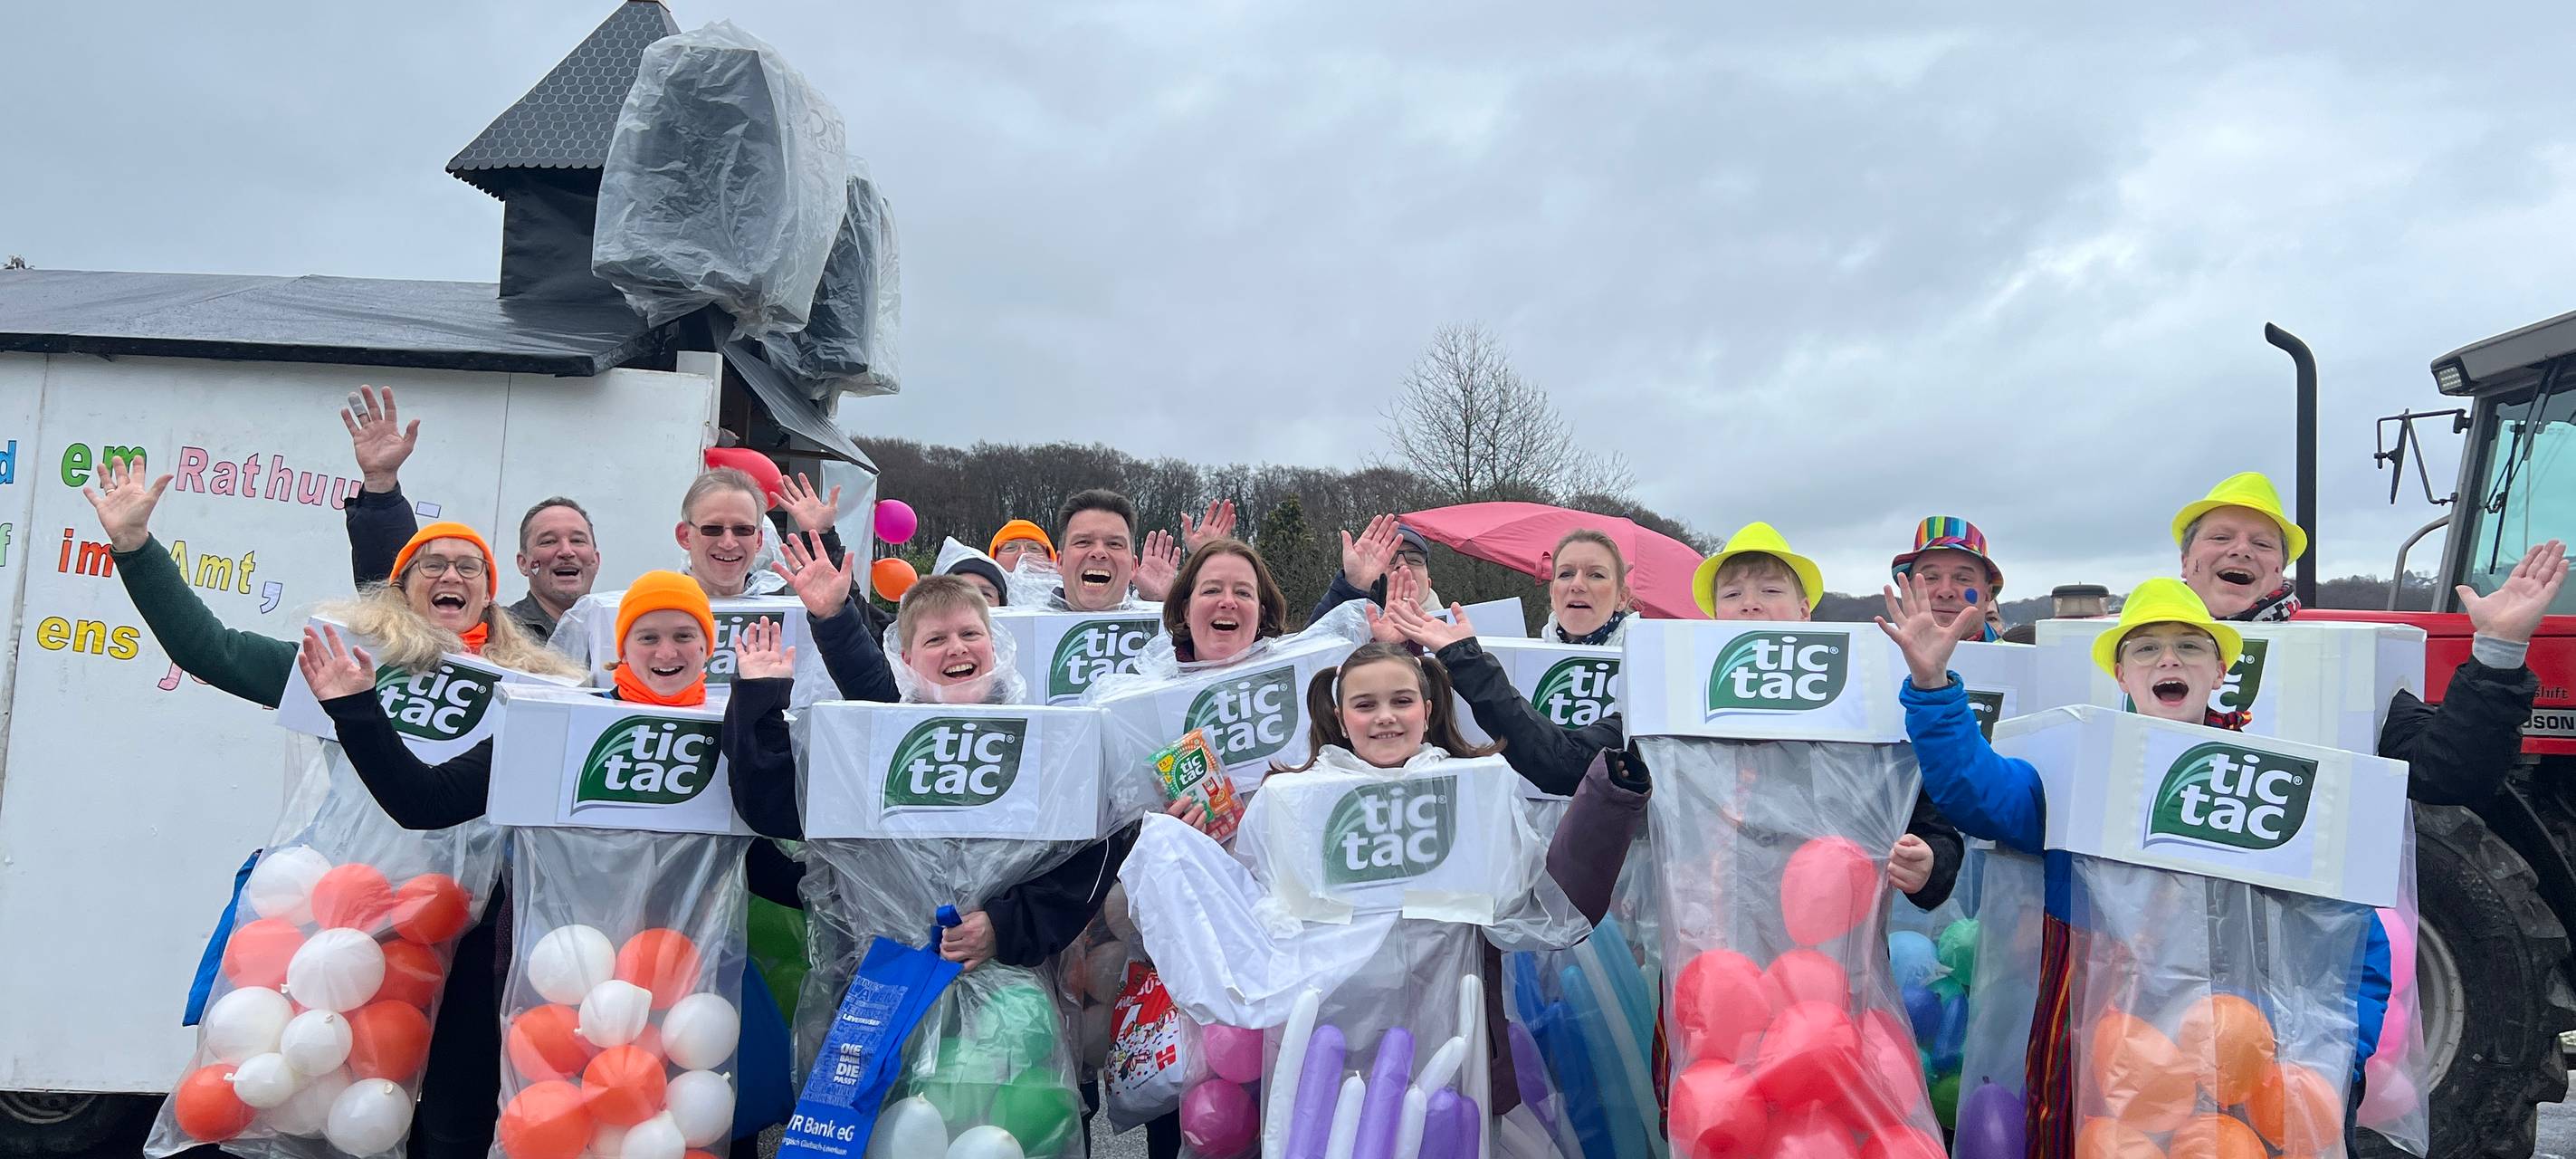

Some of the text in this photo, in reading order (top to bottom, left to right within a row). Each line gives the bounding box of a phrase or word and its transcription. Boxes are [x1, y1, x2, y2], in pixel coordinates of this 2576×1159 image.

[176, 446, 362, 510] Rathuu
[58, 528, 114, 578] im
[36, 617, 140, 660] ens
[1754, 636, 1830, 672] tic
[407, 666, 479, 708] tic
[1214, 682, 1282, 723] tic
[1731, 666, 1828, 700] tac
[2533, 685, 2569, 700] shift
[380, 685, 467, 734] tac
[631, 722, 708, 762] tic
[932, 723, 1006, 762] tic
[1179, 754, 1201, 771] tic
[604, 752, 698, 793] tac
[908, 758, 1000, 795] tac
[1178, 764, 1205, 785] tac
[2209, 752, 2294, 805] tic
[1361, 787, 1437, 833] tic
[2180, 785, 2285, 840] tac
[1341, 829, 1437, 870] tac
[835, 1062, 860, 1078] DIE
[804, 1116, 836, 1138] Bank
[836, 1125, 855, 1142] eG
